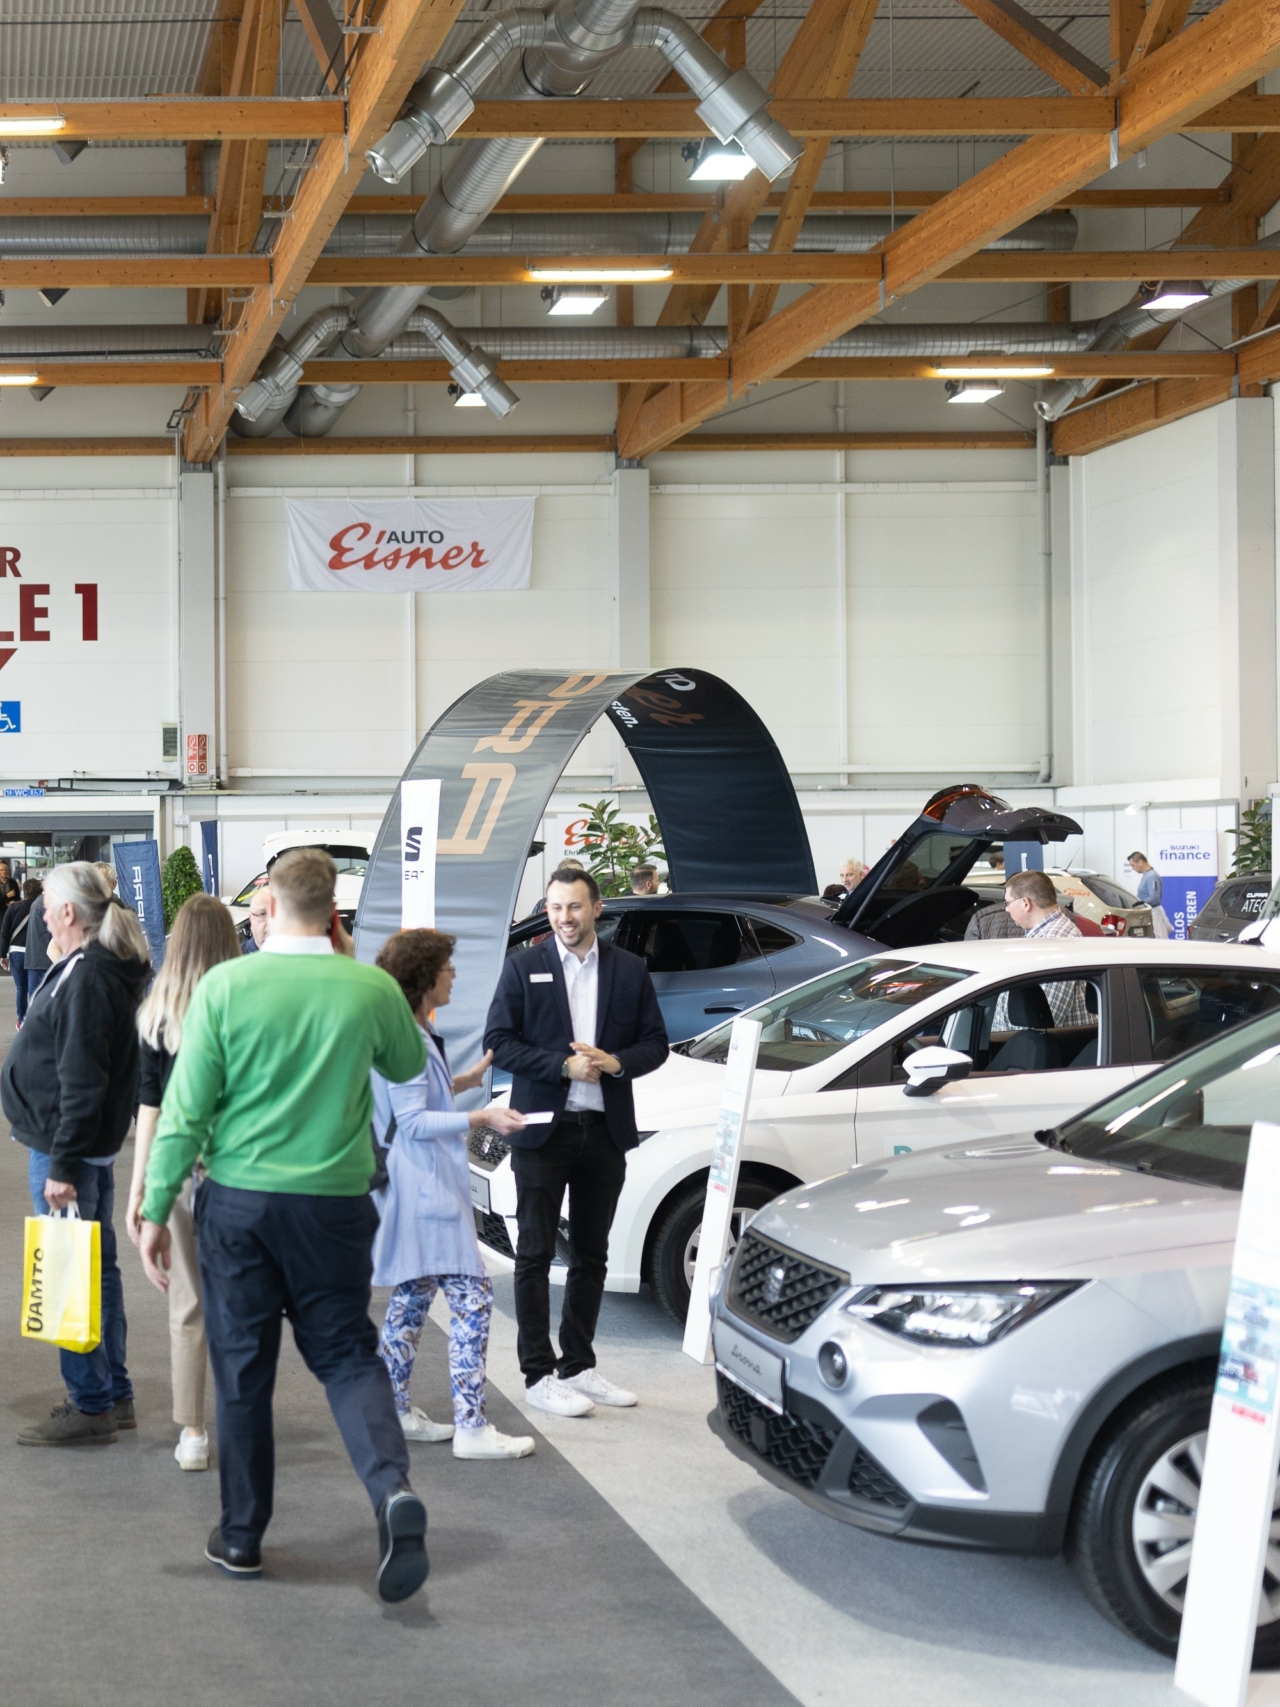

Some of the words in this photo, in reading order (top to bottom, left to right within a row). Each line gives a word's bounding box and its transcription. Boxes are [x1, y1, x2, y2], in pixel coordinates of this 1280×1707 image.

[385, 531, 444, 545] AUTO
[328, 522, 490, 572] Eisner
[74, 582, 99, 641] 1
[14, 789, 29, 797] WC
[1159, 849, 1211, 861] finance
[1240, 899, 1268, 913] ATEC
